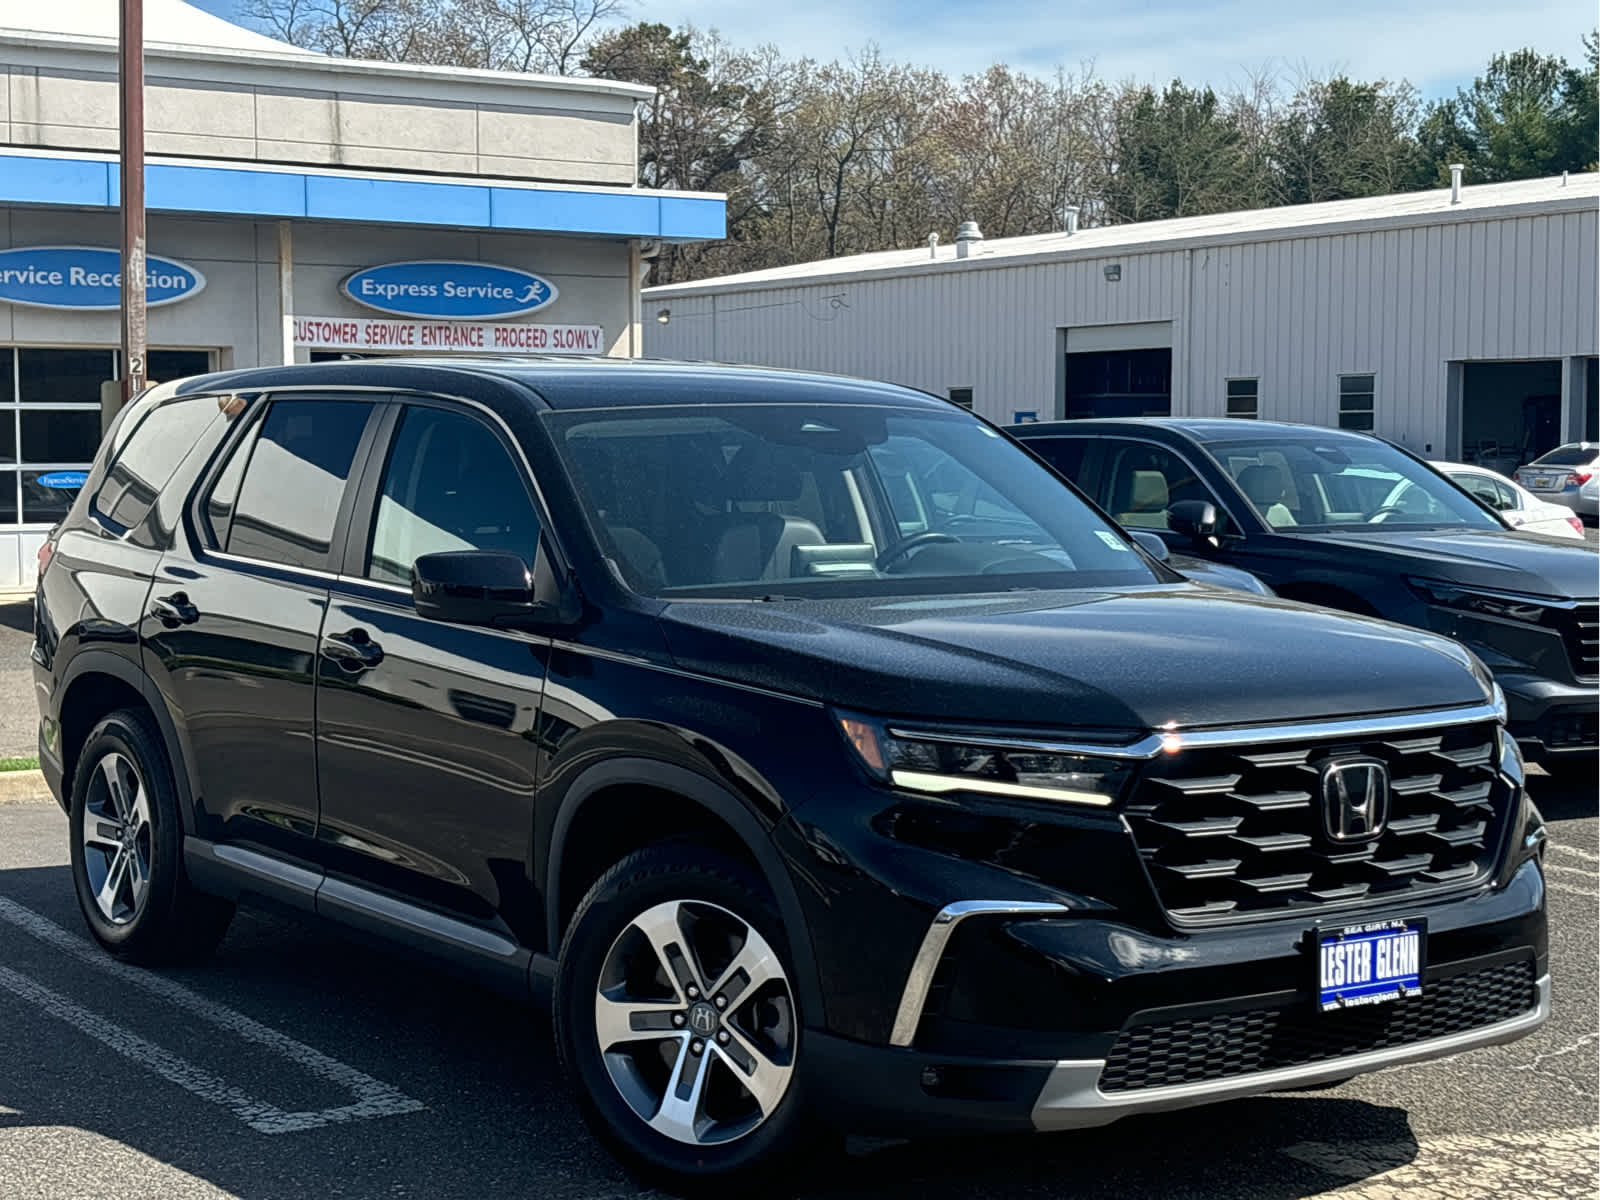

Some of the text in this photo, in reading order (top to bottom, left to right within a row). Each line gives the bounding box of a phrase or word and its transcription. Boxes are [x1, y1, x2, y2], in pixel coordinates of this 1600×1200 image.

[0, 265, 187, 289] rvice Recetion
[361, 279, 514, 300] Express Service
[364, 324, 416, 345] SERVICE
[421, 325, 484, 347] ENTRANCE
[494, 327, 548, 348] PROCEED
[552, 328, 600, 349] SLOWLY
[131, 357, 142, 374] 2
[1320, 934, 1419, 988] LESTER GLENN
